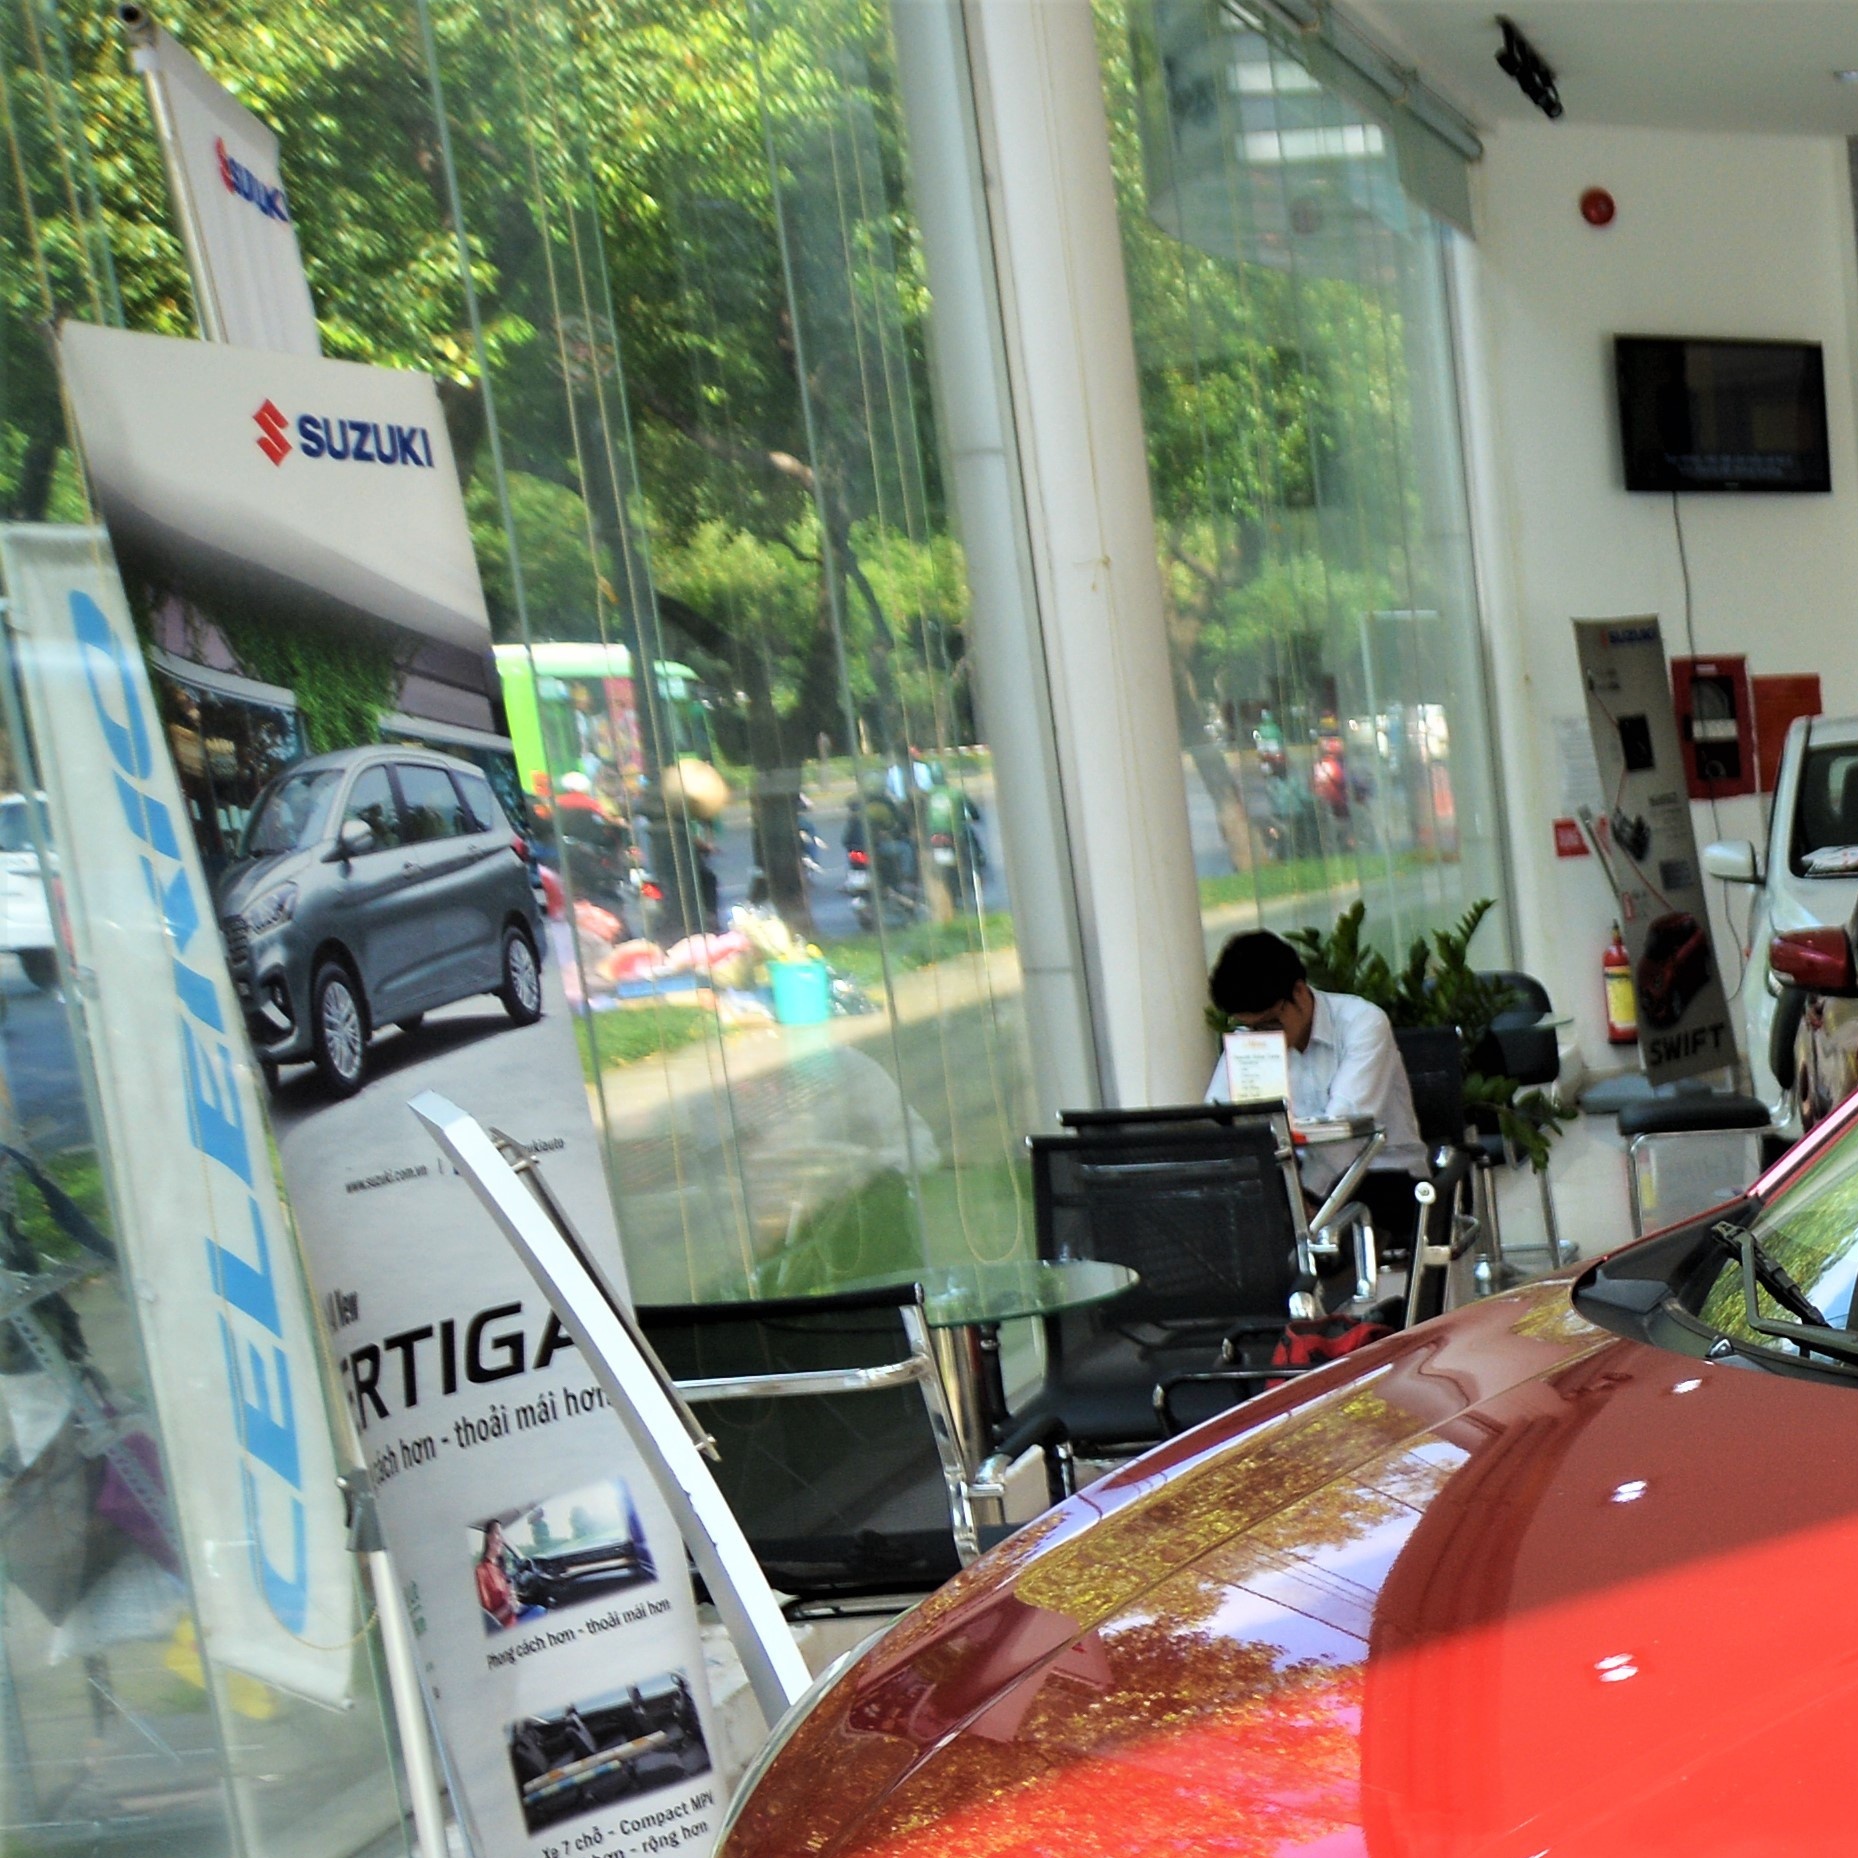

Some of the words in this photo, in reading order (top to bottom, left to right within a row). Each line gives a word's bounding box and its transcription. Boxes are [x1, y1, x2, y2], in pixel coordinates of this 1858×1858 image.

[297, 414, 435, 469] SUZUKI
[1650, 1020, 1726, 1067] SWIFT
[67, 588, 309, 1636] CELERIO
[341, 1301, 575, 1430] RTIGA
[400, 1434, 437, 1471] hơn
[454, 1404, 510, 1449] thoải
[516, 1391, 558, 1431] mái
[517, 1634, 546, 1658] cách
[547, 1626, 576, 1648] hơn
[585, 1609, 622, 1636] thoải
[624, 1601, 648, 1625] mái
[649, 1597, 672, 1617] hơn
[561, 1839, 571, 1856] 7
[575, 1825, 604, 1853] chỗ
[619, 1800, 690, 1837] Compact
[690, 1788, 715, 1812] MPV
[641, 1829, 680, 1855] rộng
[681, 1819, 709, 1842] hơn
